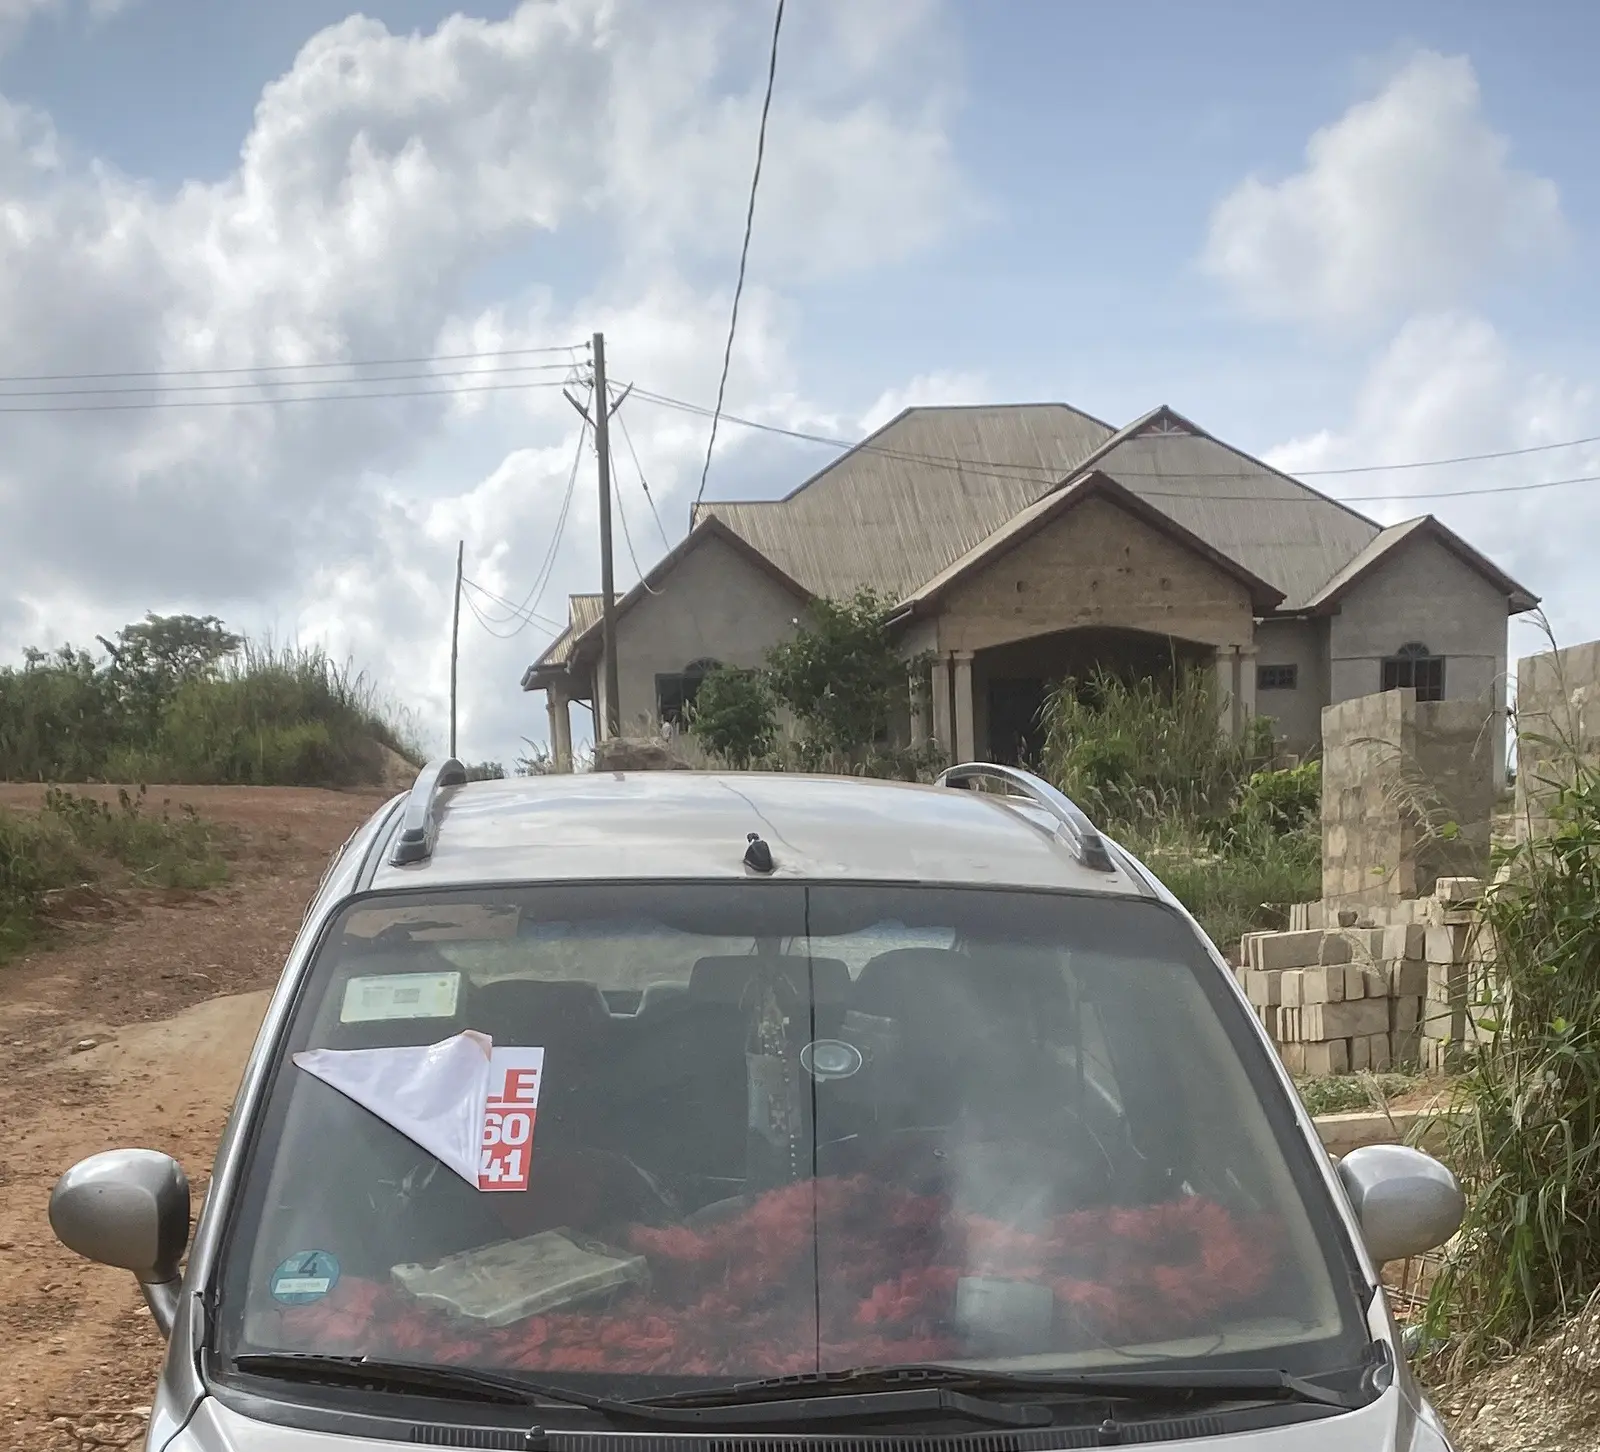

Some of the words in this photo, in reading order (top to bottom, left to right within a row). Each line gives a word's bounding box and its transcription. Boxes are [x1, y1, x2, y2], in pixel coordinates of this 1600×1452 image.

[487, 1069, 537, 1103] E
[482, 1112, 530, 1146] 60
[480, 1149, 524, 1182] 41
[298, 1252, 318, 1276] 4
